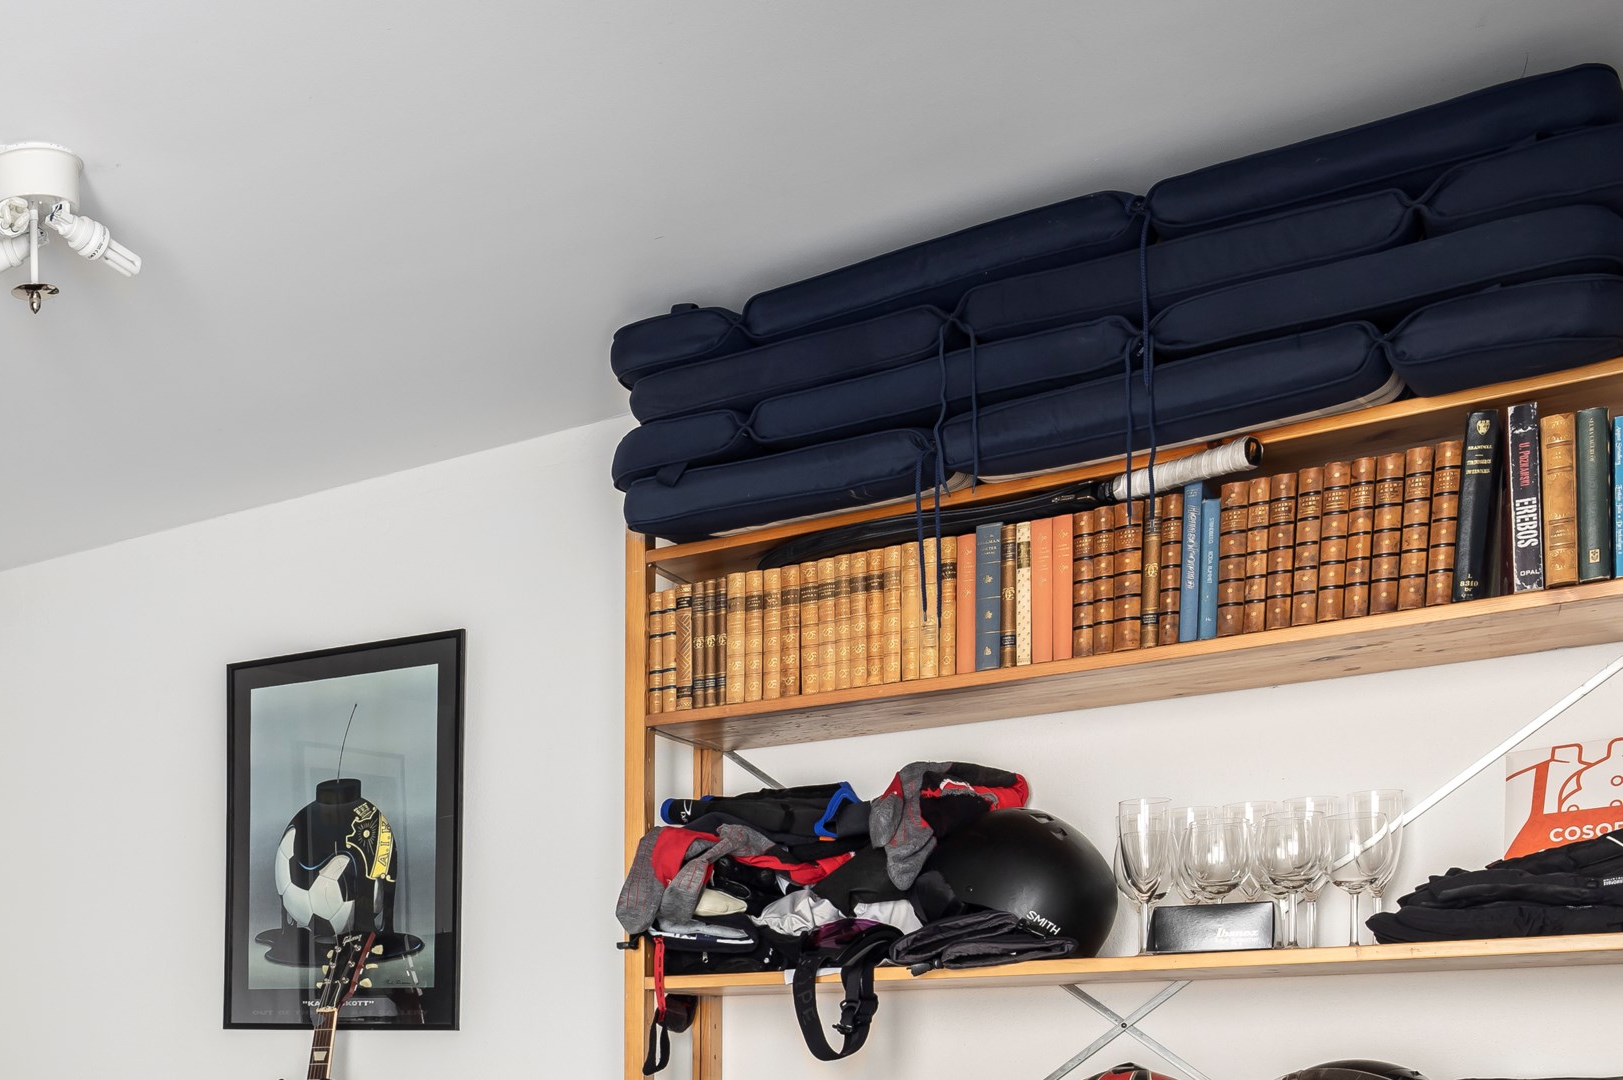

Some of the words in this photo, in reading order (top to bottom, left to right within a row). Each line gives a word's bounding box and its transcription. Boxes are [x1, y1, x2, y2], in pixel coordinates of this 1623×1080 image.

[1518, 451, 1529, 485] POZNANSKI
[1515, 498, 1537, 546] EREBOS
[1520, 568, 1539, 577] OPAL
[1026, 910, 1062, 936] SMITH
[1216, 928, 1259, 938] Ibanez
